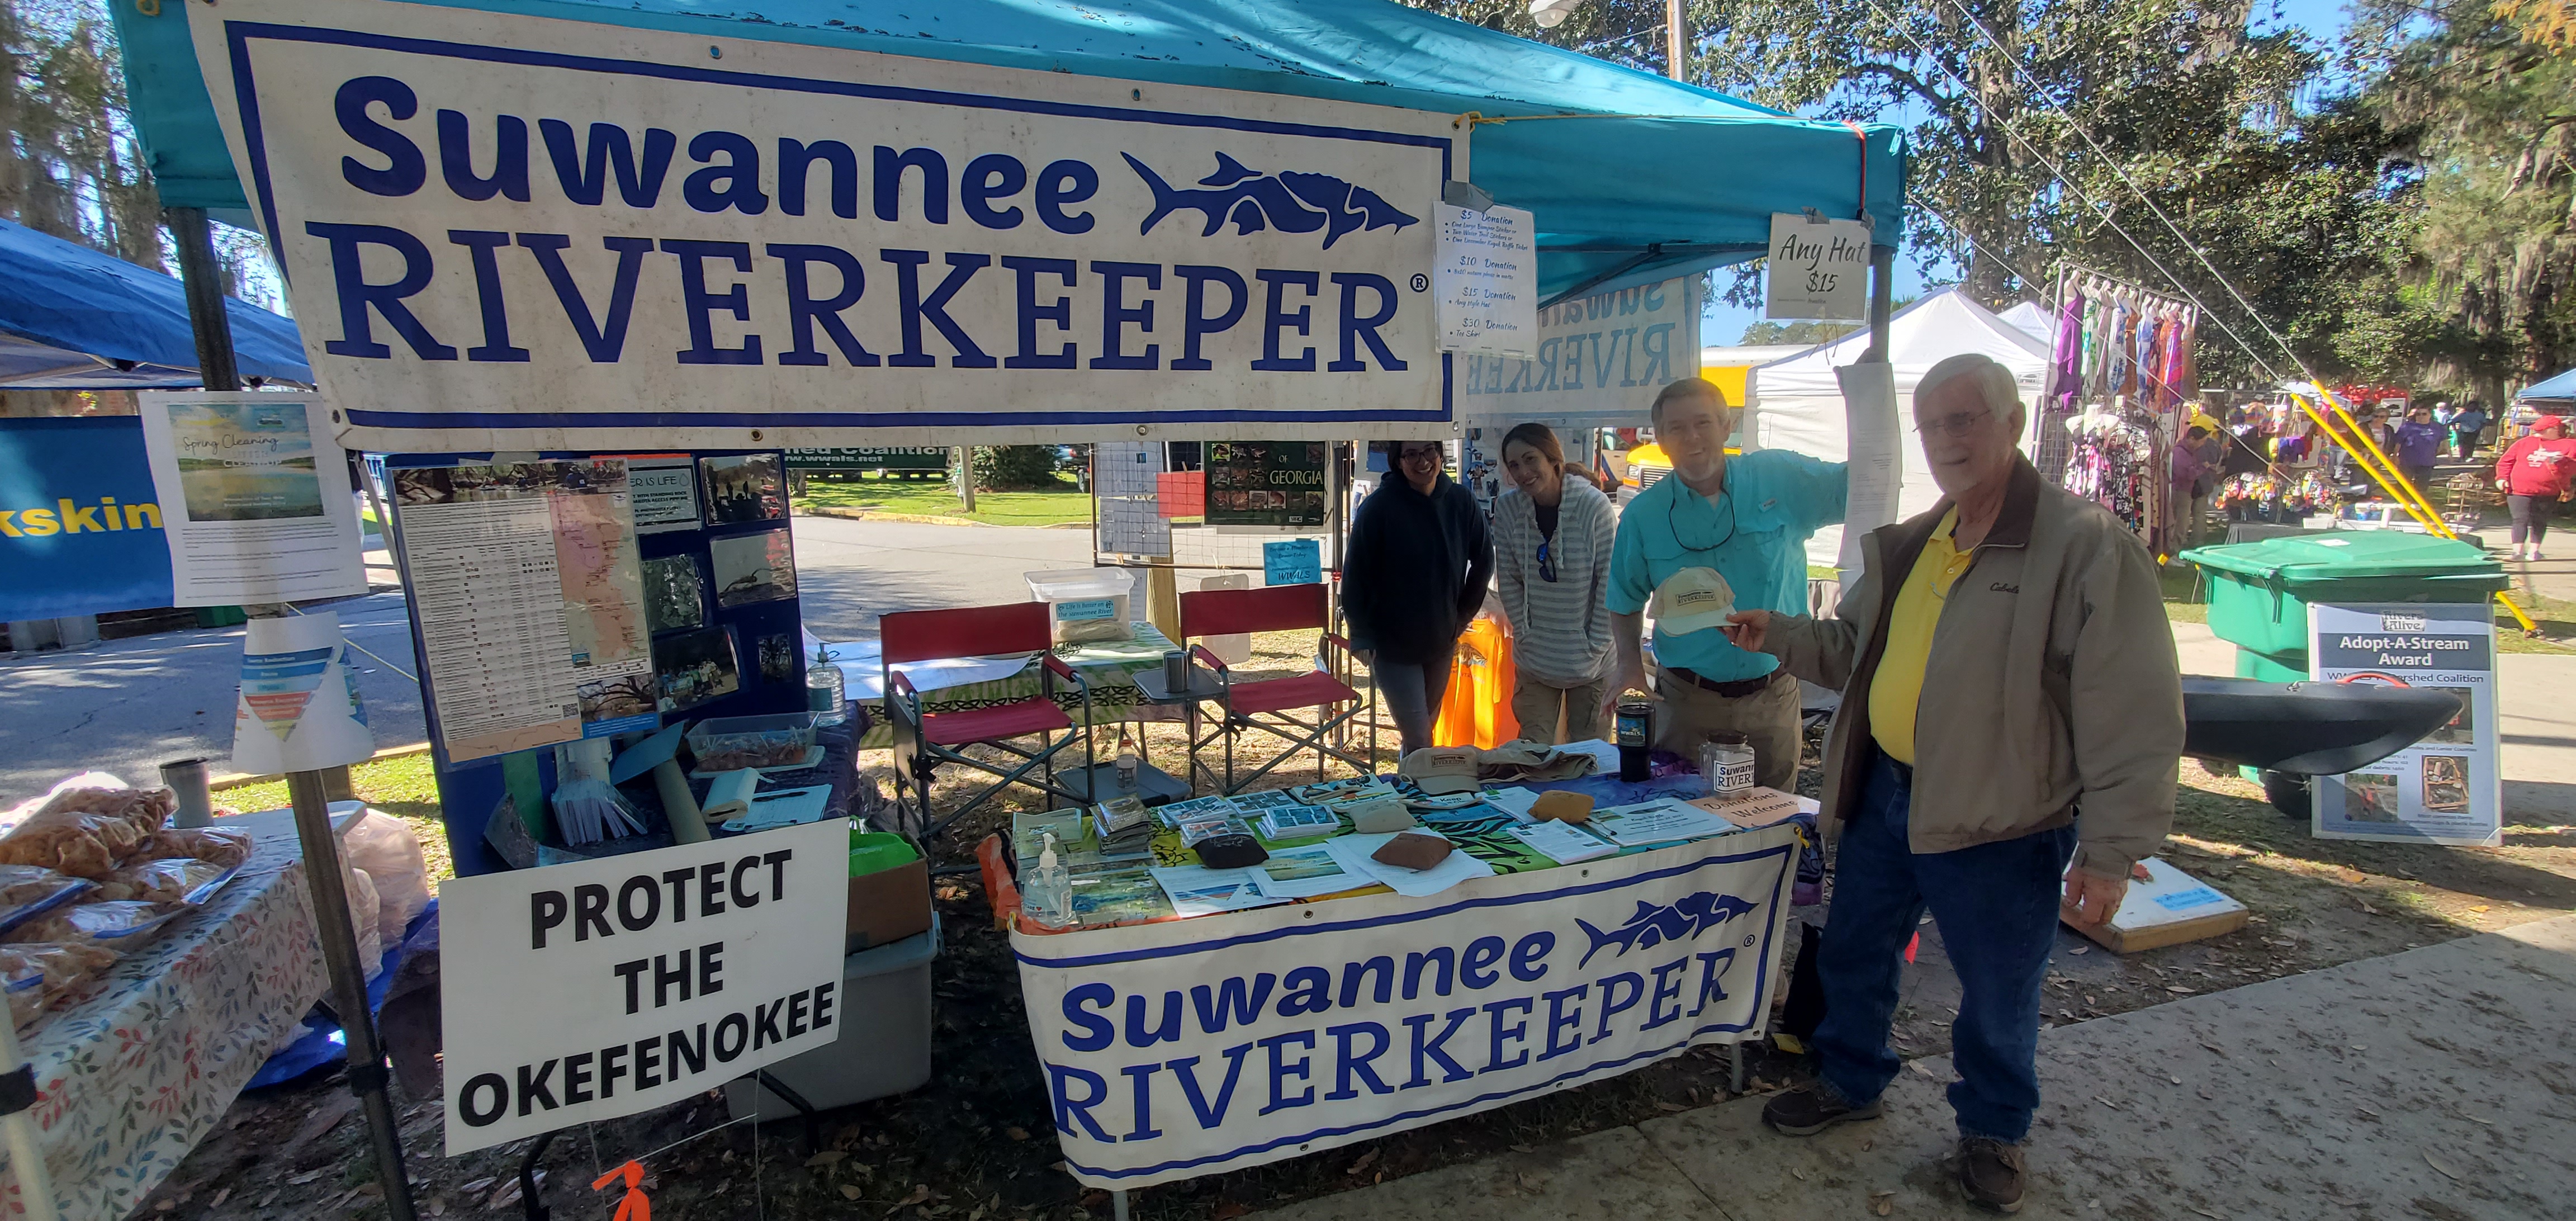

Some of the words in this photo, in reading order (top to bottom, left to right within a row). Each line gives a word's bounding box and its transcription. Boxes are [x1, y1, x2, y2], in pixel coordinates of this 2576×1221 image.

[334, 75, 1099, 234] Suwannee
[1460, 209, 1472, 220] $5
[1481, 212, 1513, 225] Donation
[1778, 233, 1823, 271] Any
[1827, 235, 1867, 263] Hat
[1460, 255, 1476, 266] $10
[1485, 258, 1517, 271] Donation
[1806, 271, 1839, 295] $15
[1462, 286, 1478, 296] $15
[1484, 289, 1516, 301] Donation
[1462, 317, 1480, 328] $30
[1486, 319, 1518, 331] Donation
[183, 436, 220, 455] Spring
[222, 434, 279, 452] Cleaning
[646, 477, 654, 486] IS
[1270, 470, 1323, 485] GEORGIA
[1278, 571, 1310, 581] WWALS
[2389, 621, 2421, 630] Alive
[2340, 636, 2469, 652] Adopt-A-Stream
[2379, 652, 2432, 666] Award
[2436, 674, 2483, 683] Coalition
[1717, 773, 1754, 787] RIVER
[1703, 792, 1778, 810] Donations
[1731, 800, 1798, 818] Welcome
[531, 849, 792, 950] PROTECT
[614, 941, 724, 1015] THE
[1061, 930, 1556, 1053] Suwannee
[458, 981, 835, 1127] OKEFENOKEE
